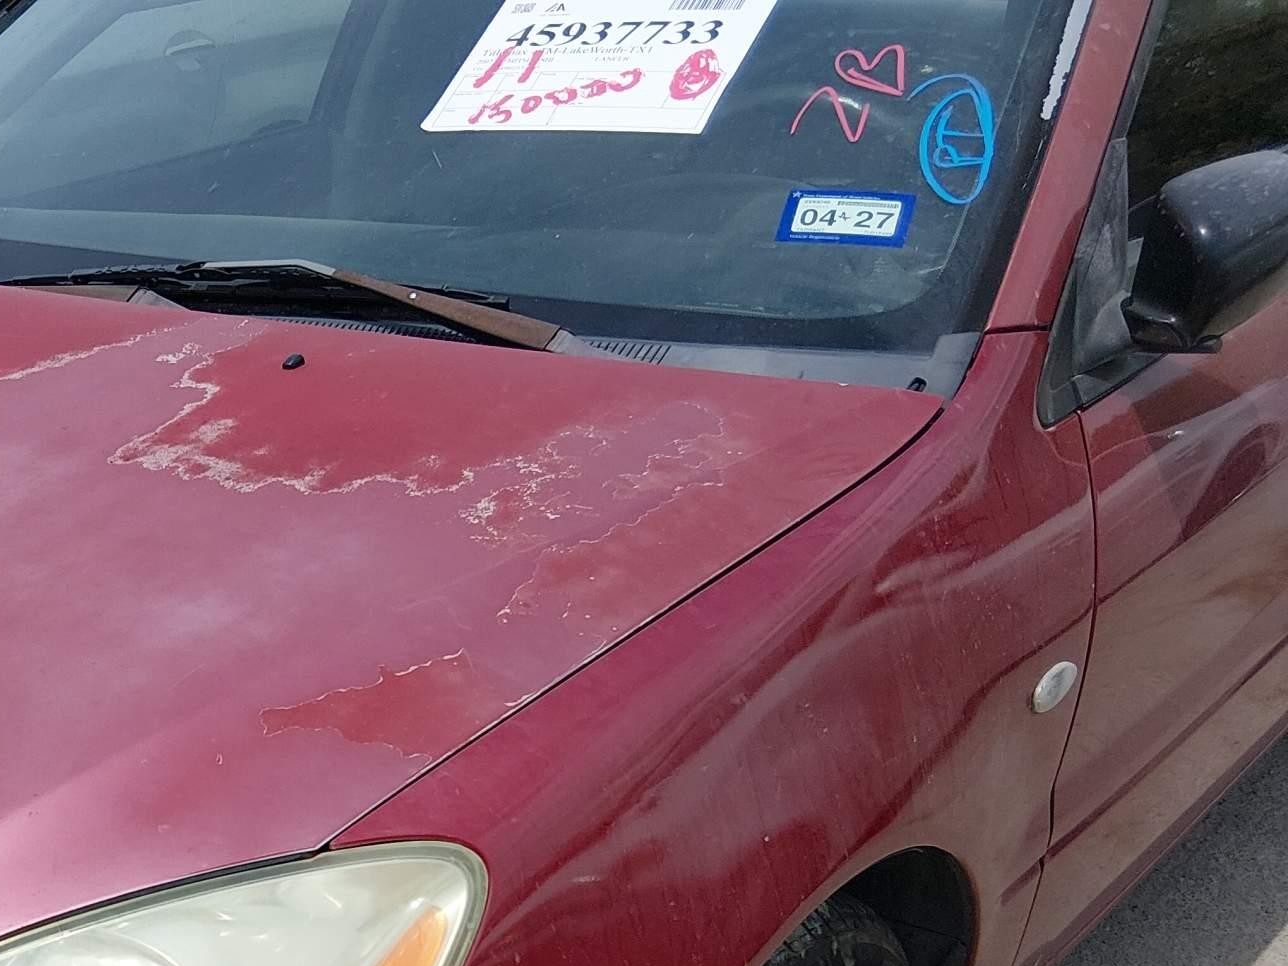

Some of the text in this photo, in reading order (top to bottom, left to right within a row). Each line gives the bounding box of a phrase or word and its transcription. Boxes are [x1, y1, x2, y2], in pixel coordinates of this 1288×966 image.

[505, 20, 724, 47] 45937733
[799, 208, 896, 229] 04 27
